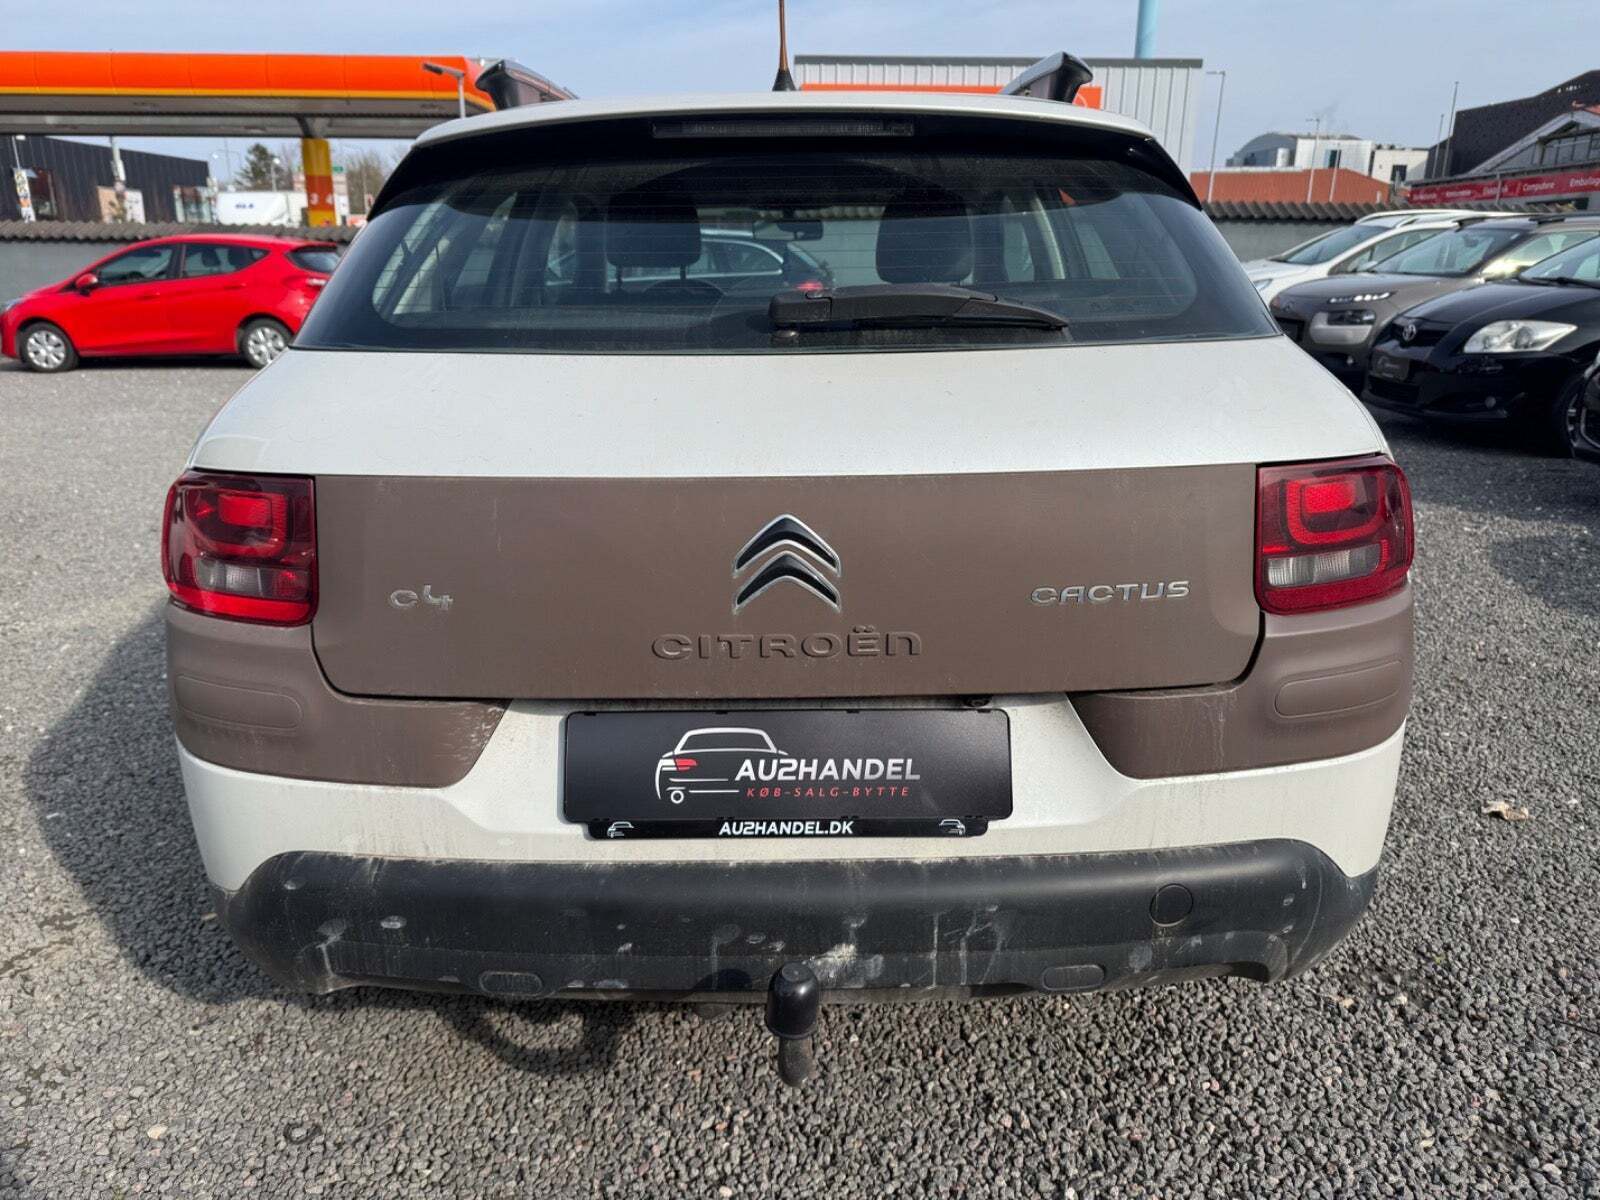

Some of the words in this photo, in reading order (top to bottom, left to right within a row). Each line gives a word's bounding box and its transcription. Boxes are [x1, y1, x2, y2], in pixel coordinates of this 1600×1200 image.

[390, 584, 453, 610] C4
[1030, 580, 1190, 604] CACTUS
[734, 757, 921, 782] AU2HANDEL
[746, 786, 911, 798] KØB-SALG-BYTTE
[718, 820, 854, 836] AU2HANDEL.DK
